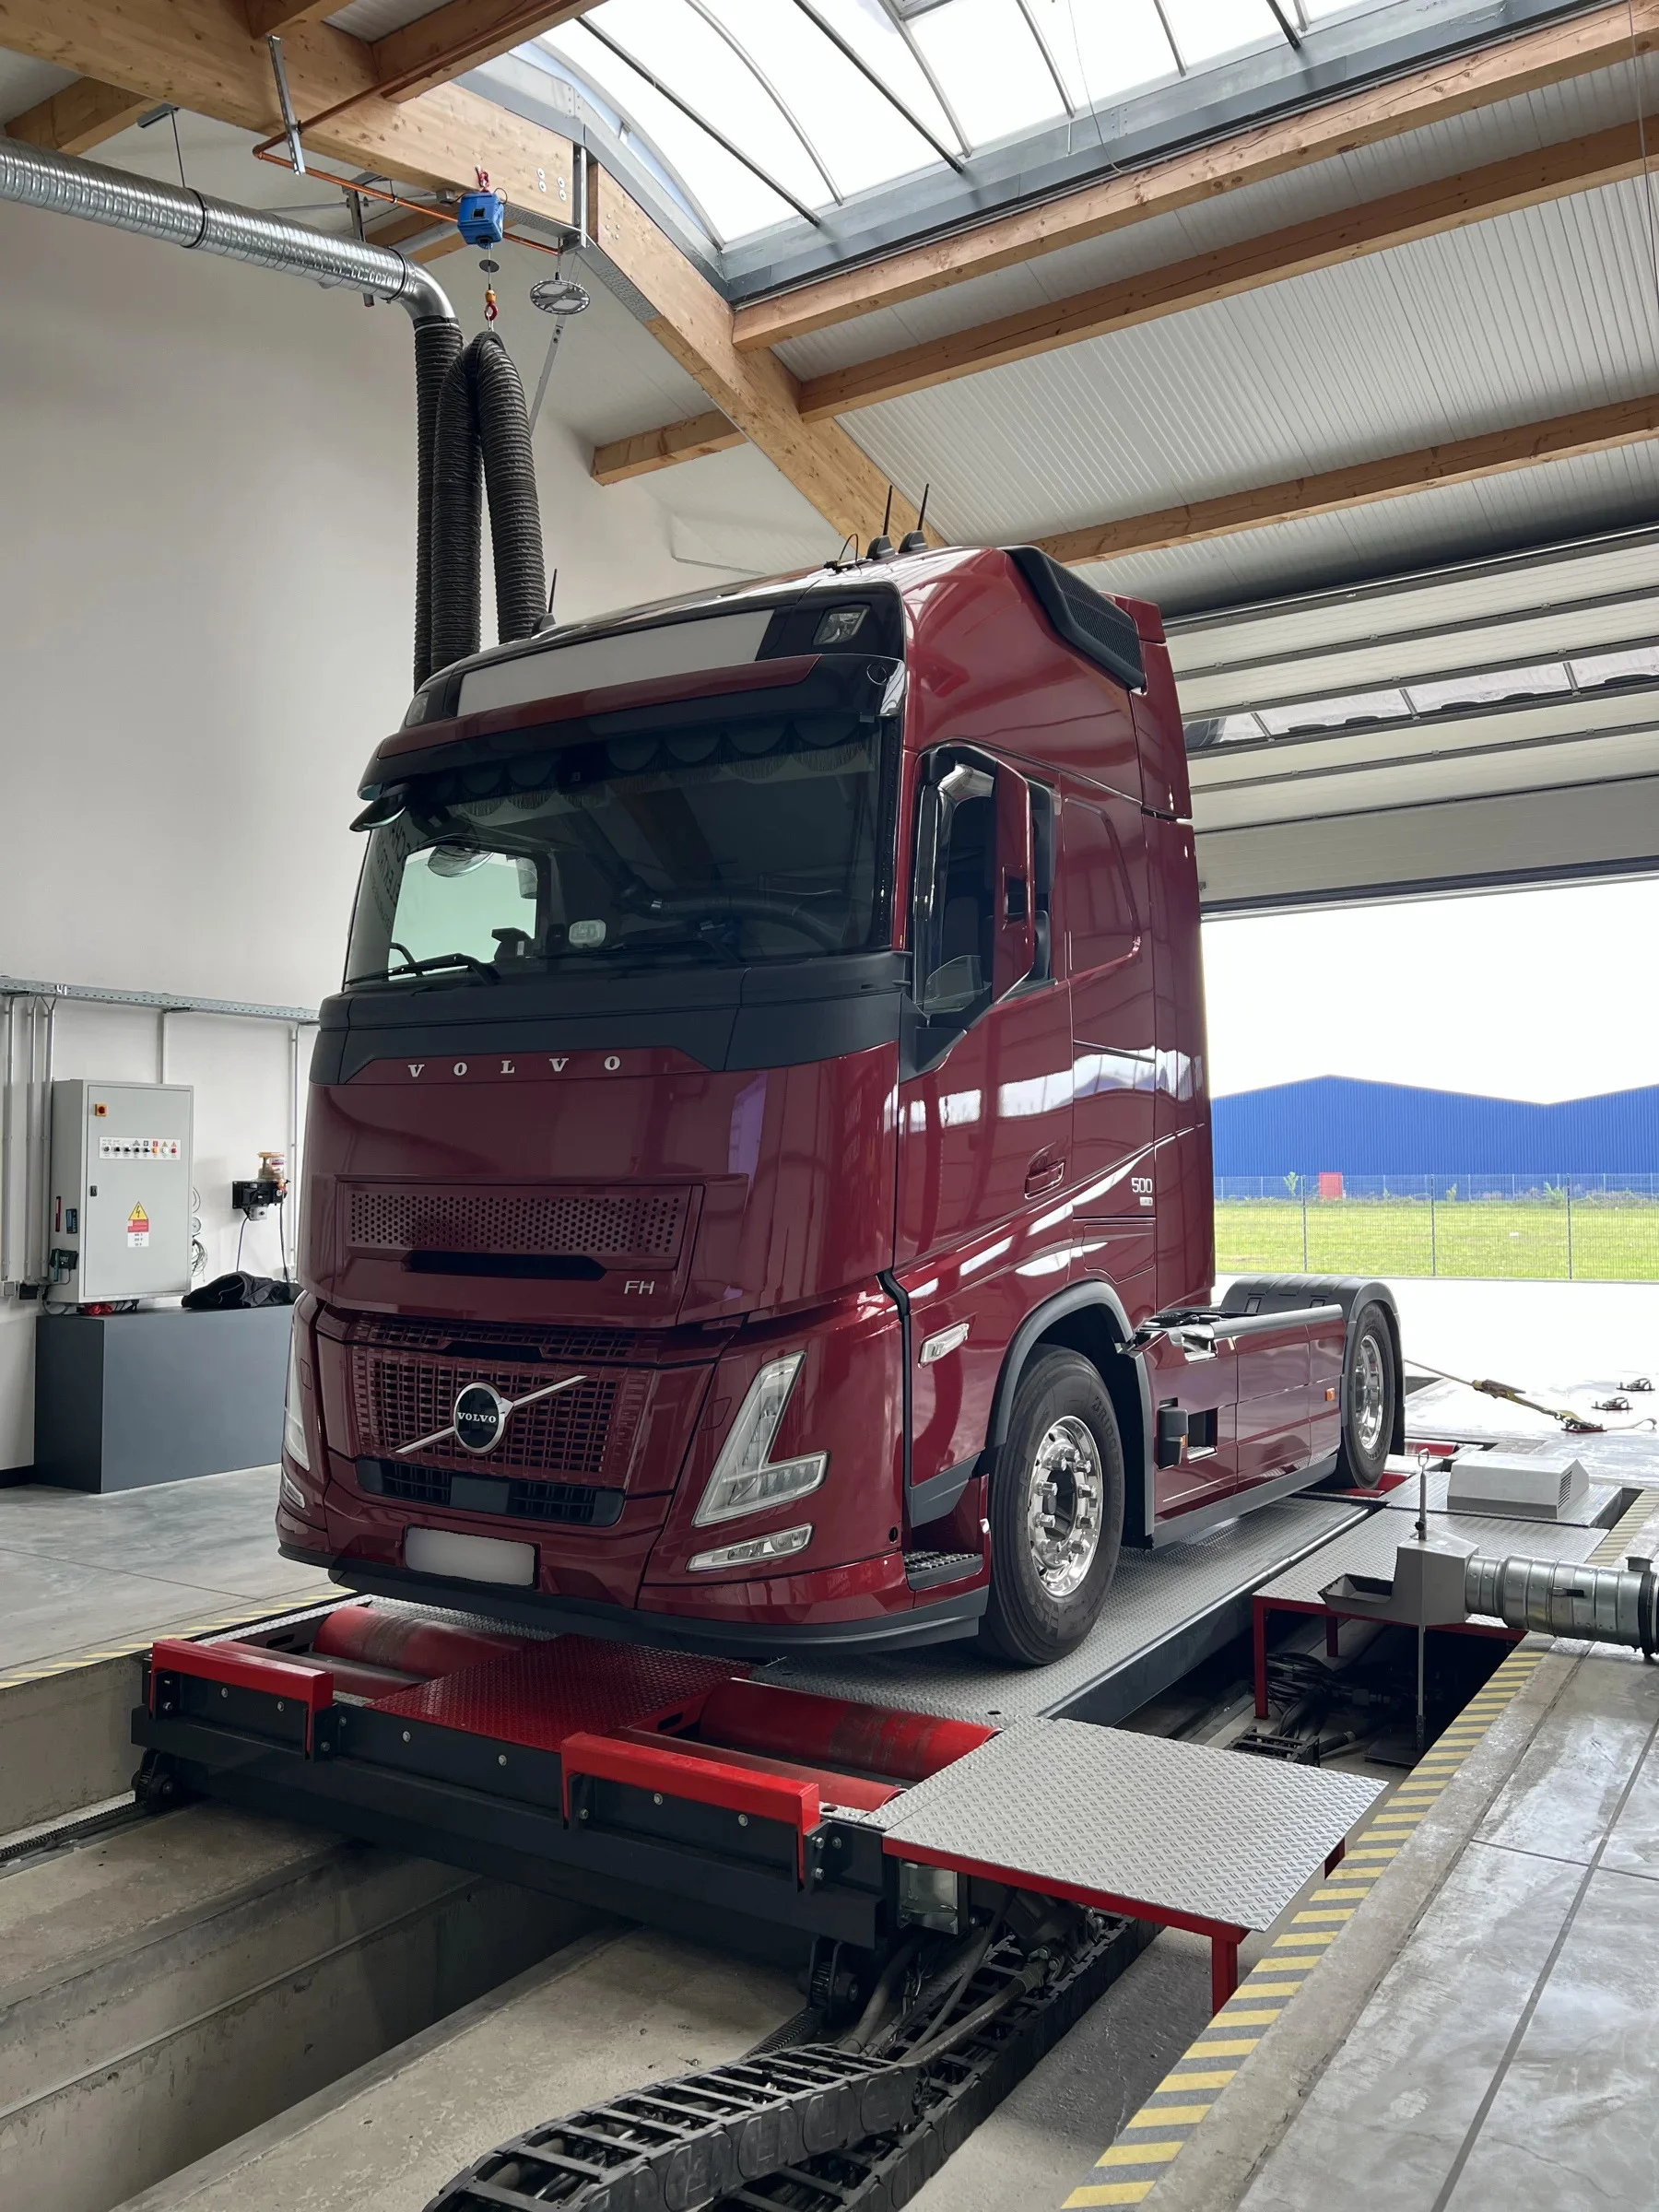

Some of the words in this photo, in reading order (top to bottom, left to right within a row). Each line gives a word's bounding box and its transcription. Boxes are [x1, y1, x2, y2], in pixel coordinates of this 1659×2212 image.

[407, 1055, 621, 1077] VOLVO
[1131, 1177, 1153, 1194] 500
[623, 1280, 655, 1295] FH
[457, 1411, 497, 1424] VOLVO
